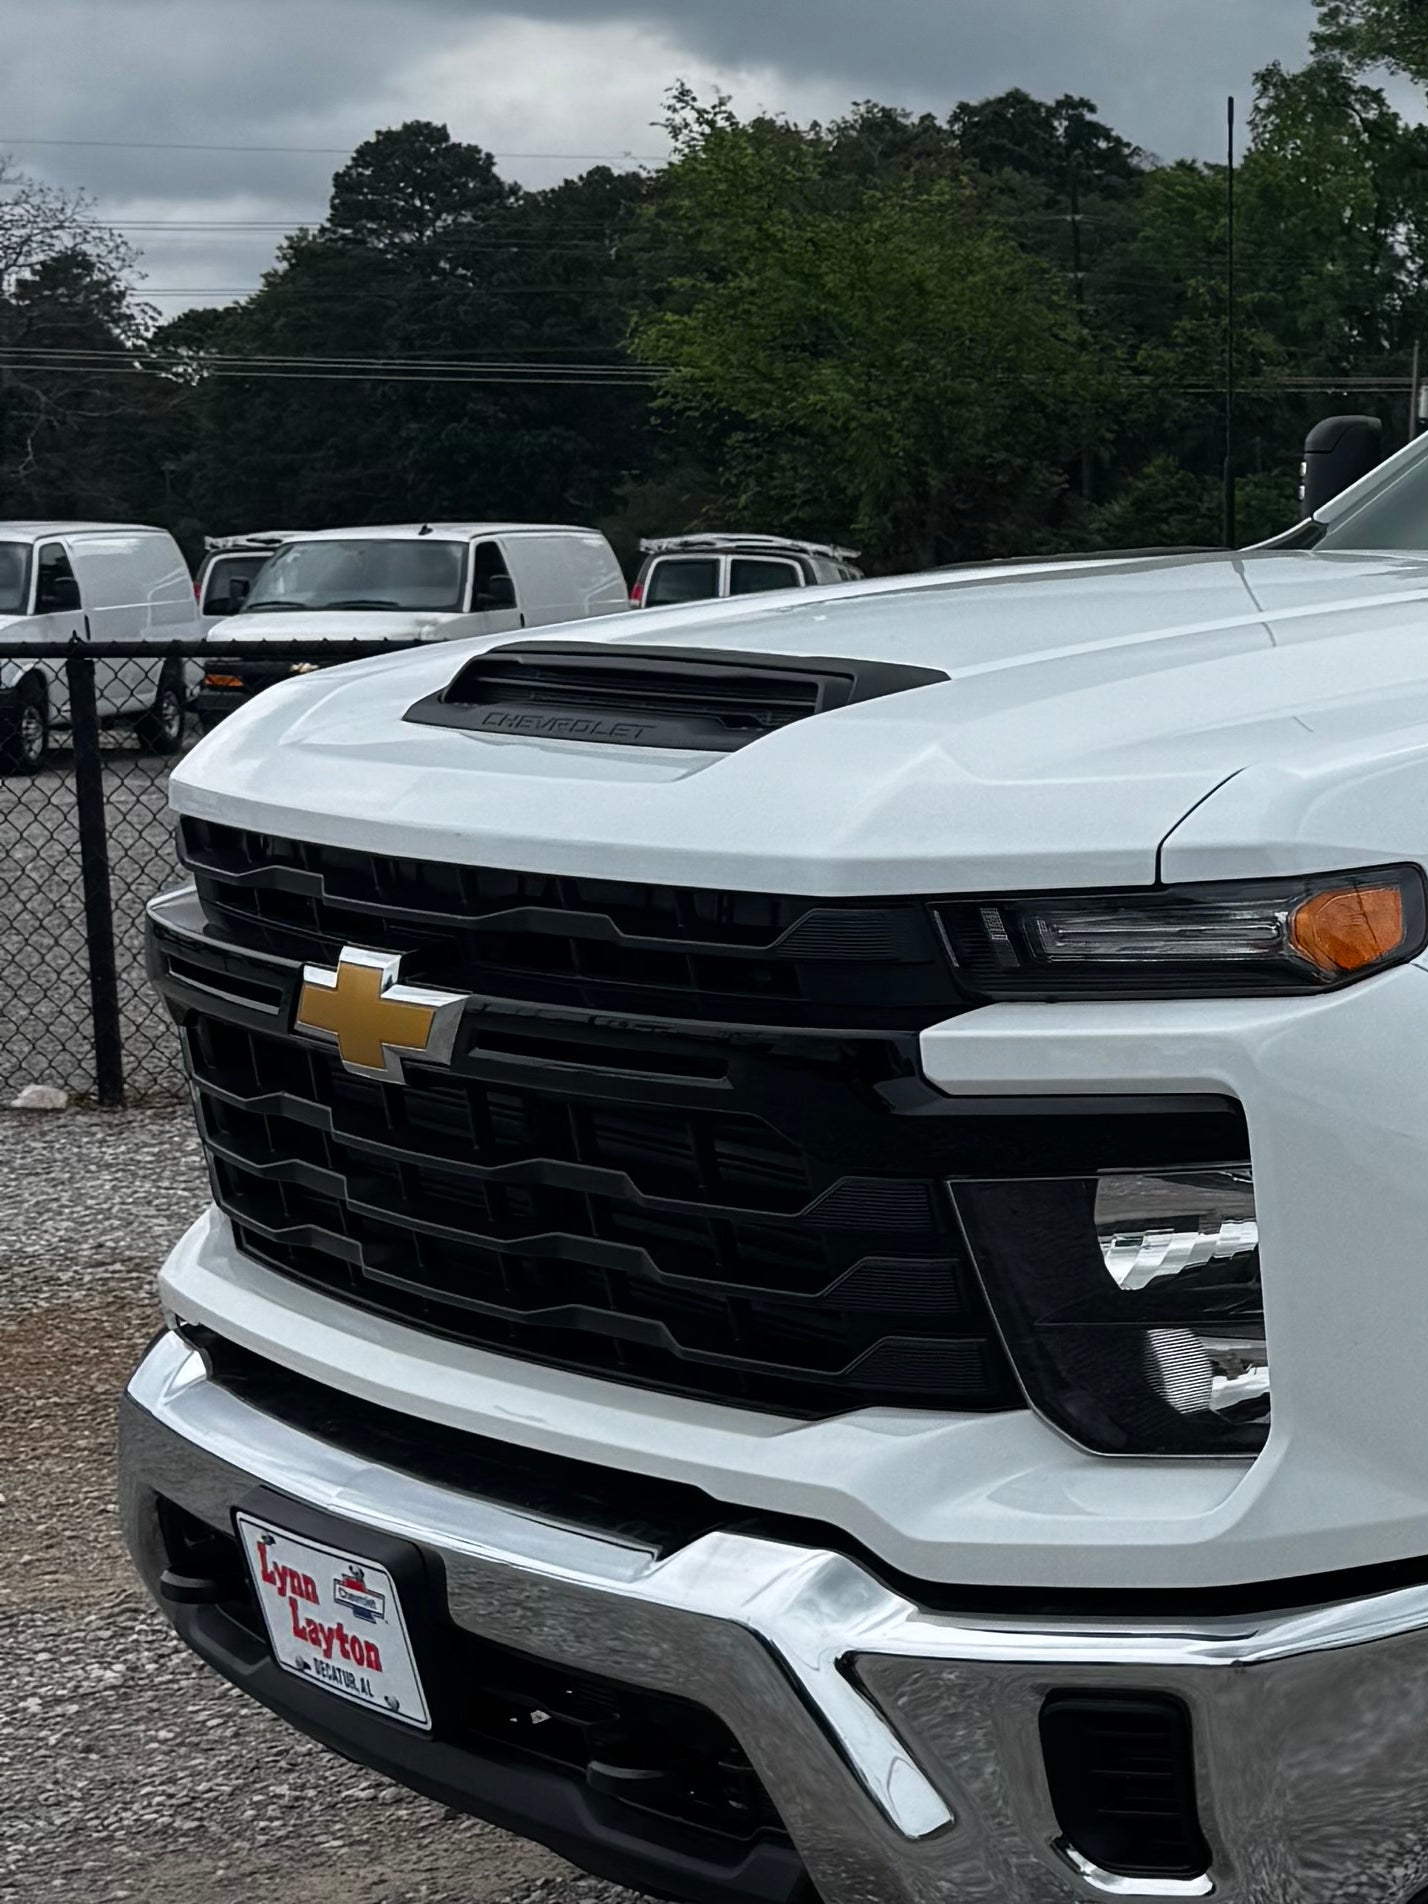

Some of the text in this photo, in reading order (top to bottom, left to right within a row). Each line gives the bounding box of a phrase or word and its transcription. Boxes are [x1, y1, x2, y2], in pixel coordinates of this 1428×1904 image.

[481, 711, 658, 739] CHEVROLET
[256, 1541, 321, 1605] Lynn
[288, 1596, 383, 1673] Layton
[360, 1677, 375, 1697] AL
